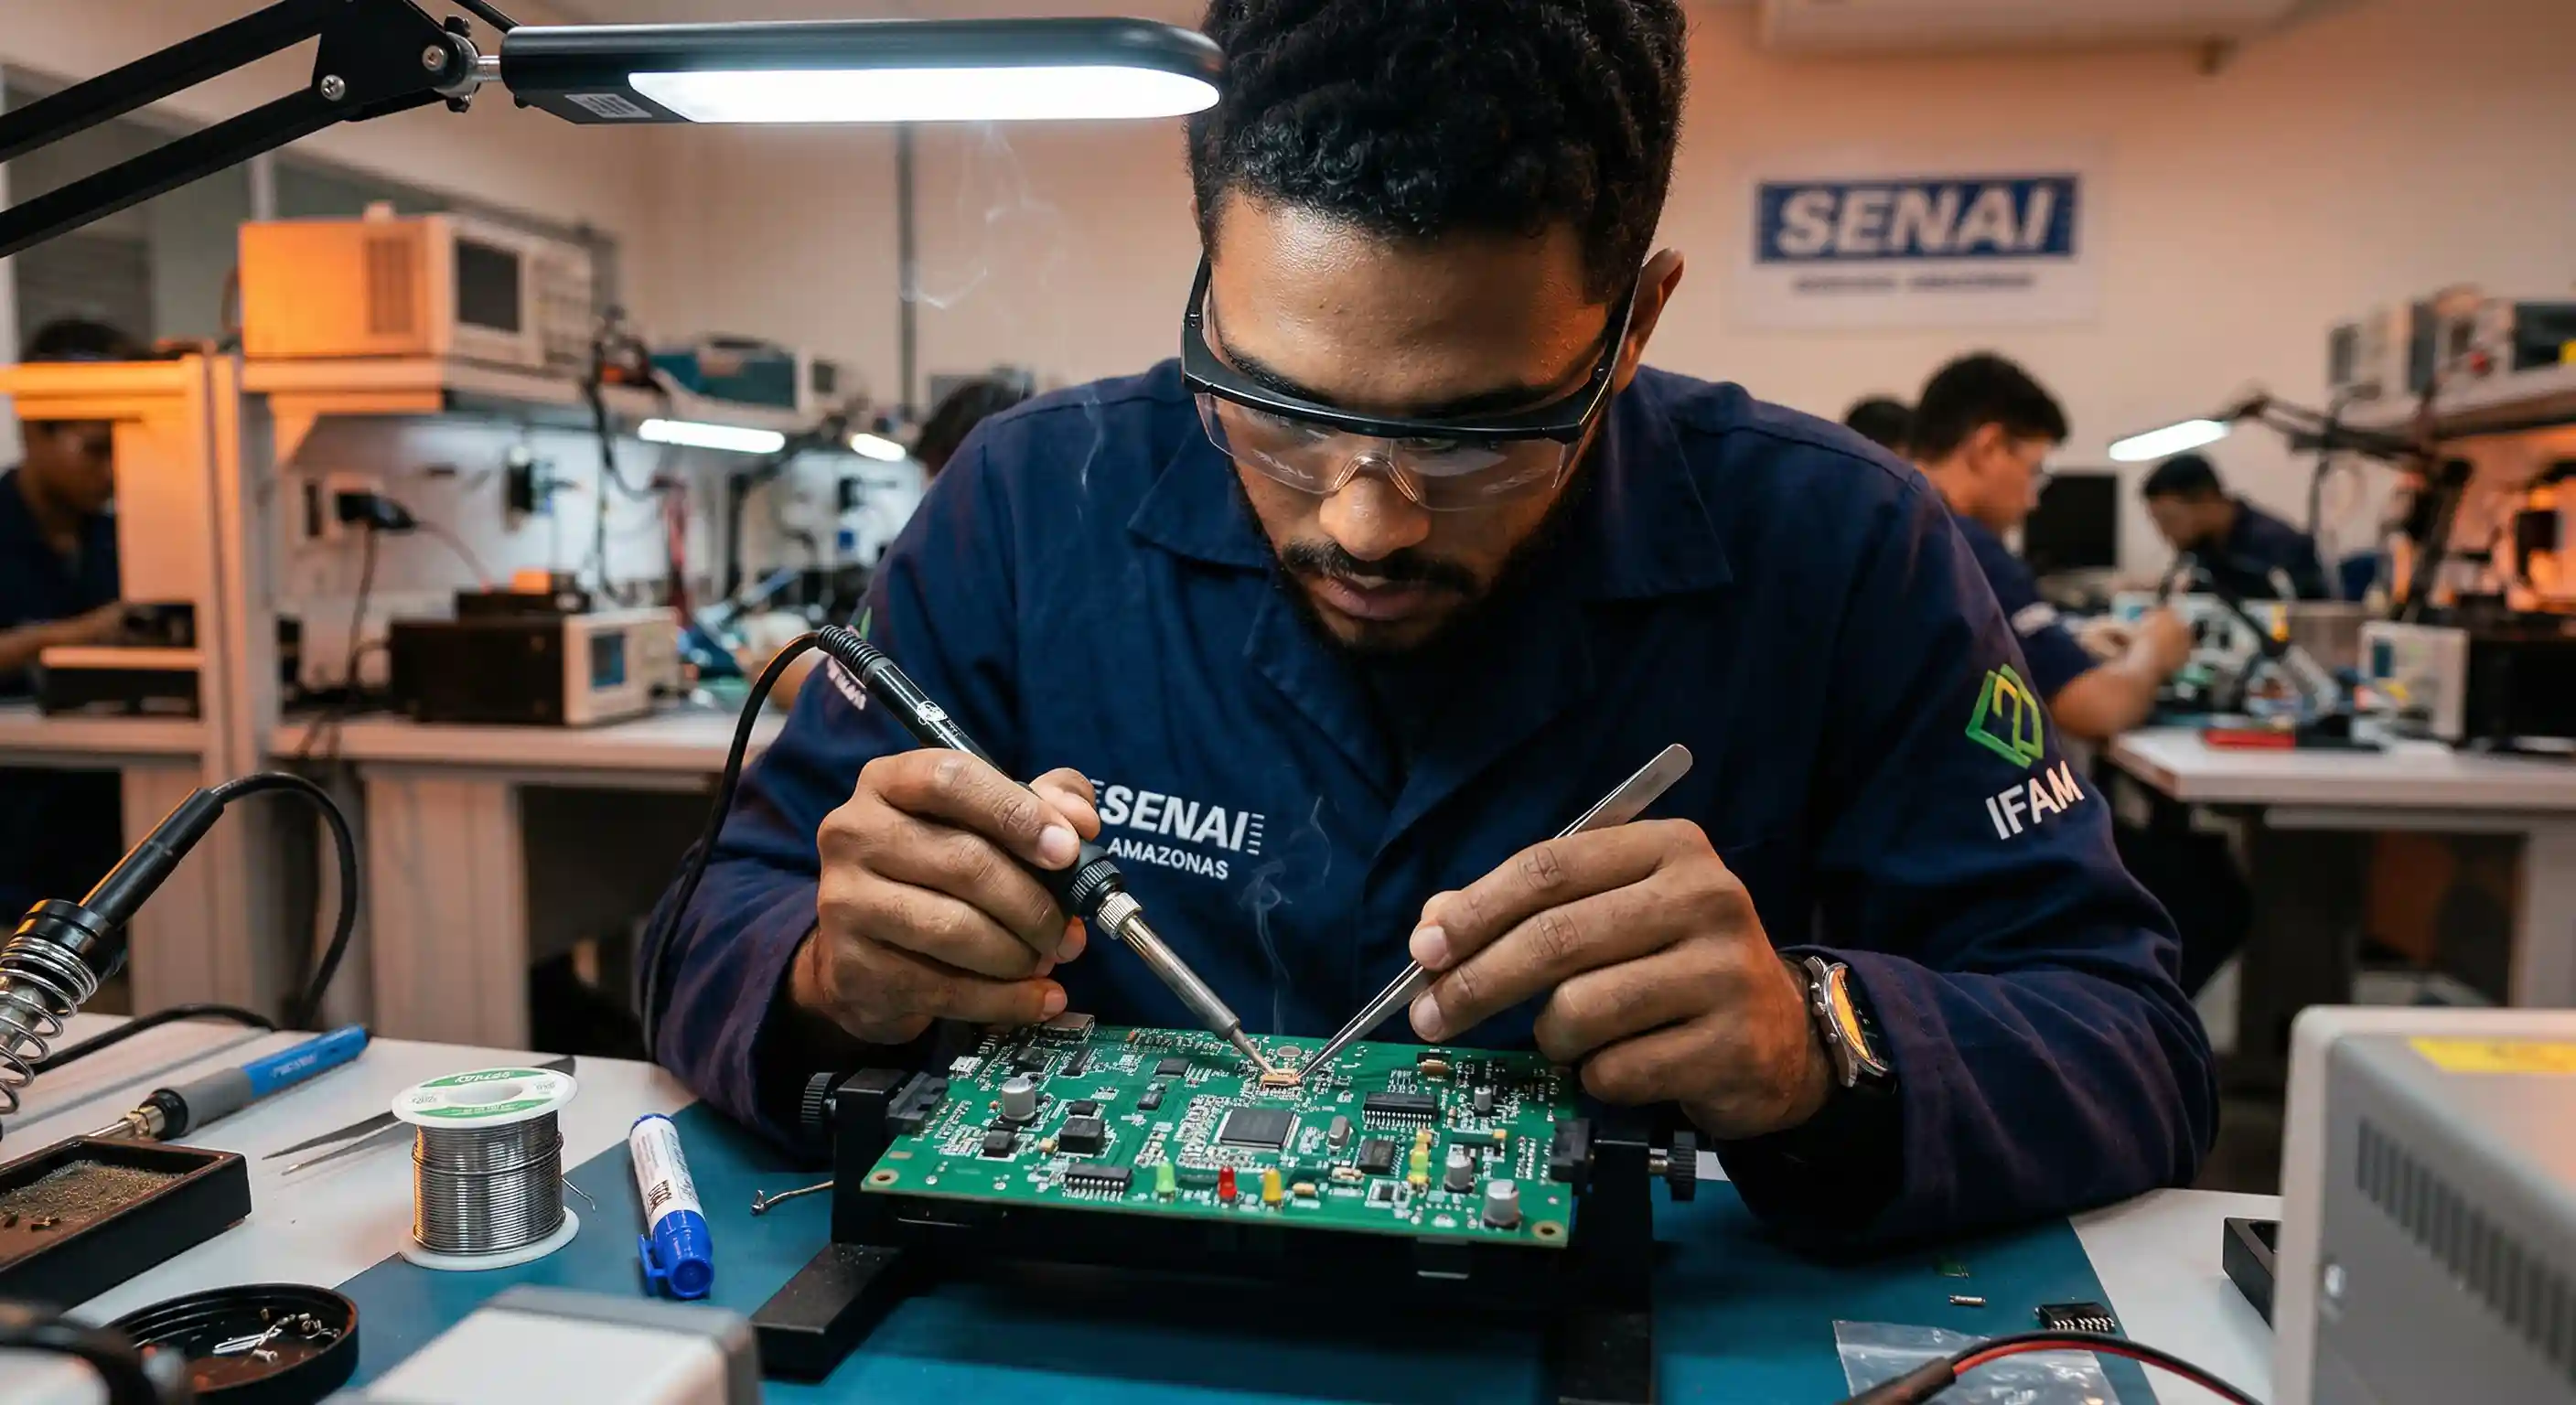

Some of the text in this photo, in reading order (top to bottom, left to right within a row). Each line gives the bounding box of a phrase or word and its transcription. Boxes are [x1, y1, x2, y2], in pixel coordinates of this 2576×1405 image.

[1777, 187, 2055, 255] SENAI
[1099, 785, 1249, 852] SENAI
[1985, 760, 2085, 840] IFAM
[1107, 837, 1229, 880] AMAZONAS
